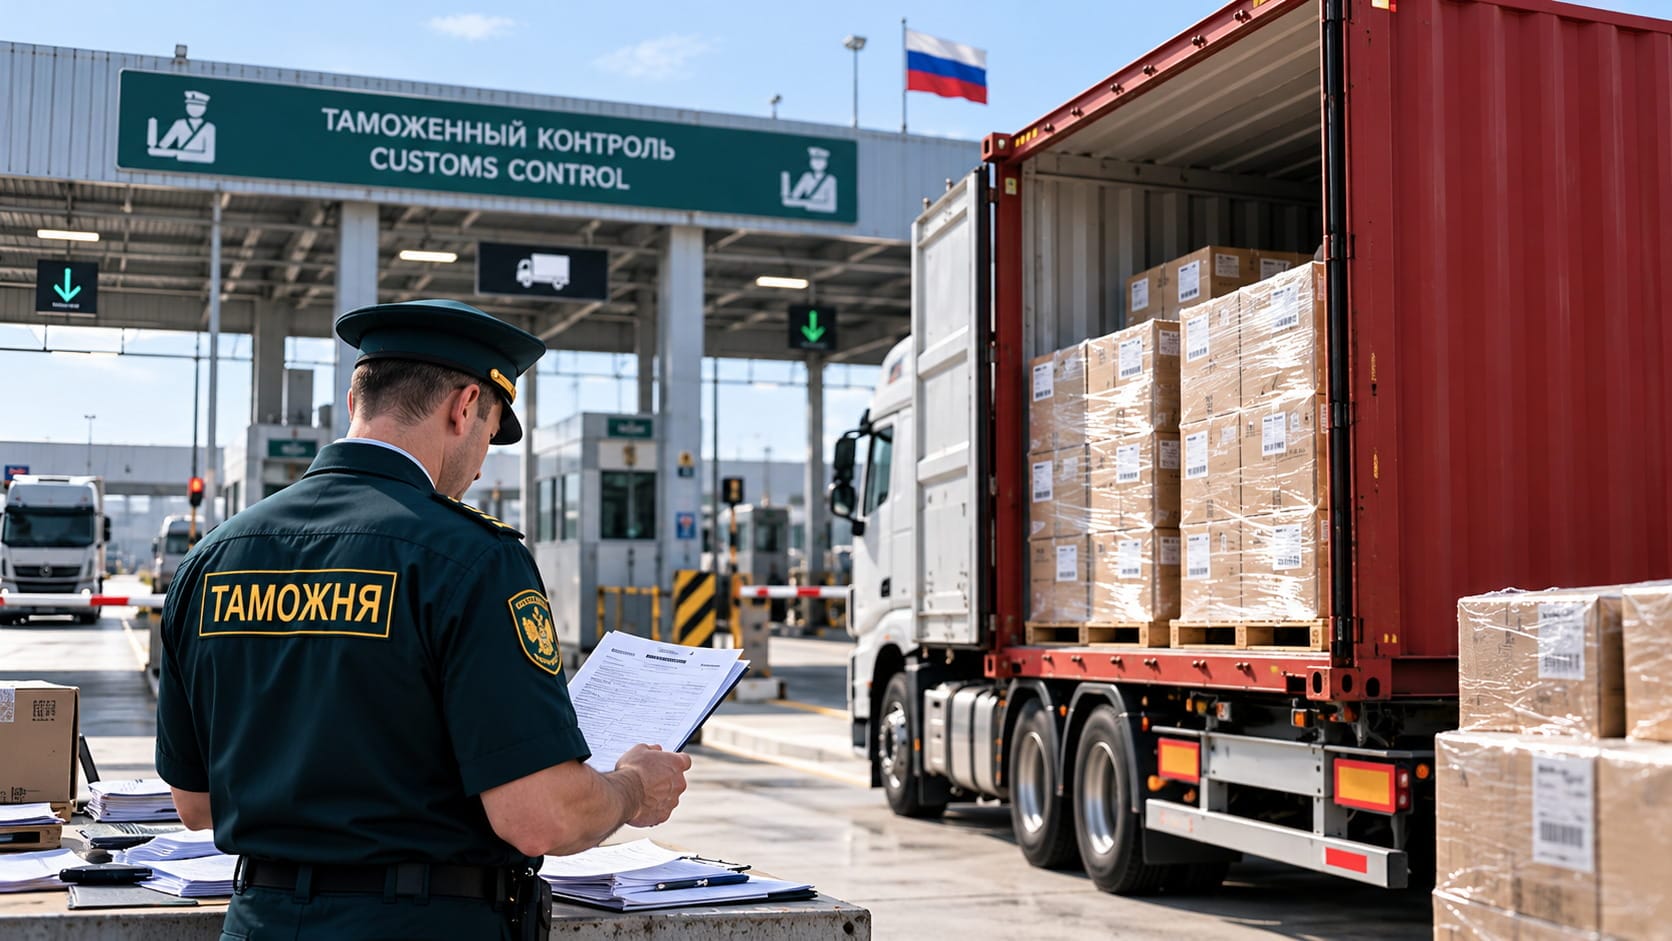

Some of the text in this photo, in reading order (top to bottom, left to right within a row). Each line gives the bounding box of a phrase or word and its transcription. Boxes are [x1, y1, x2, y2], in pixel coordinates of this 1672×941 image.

[321, 107, 675, 161] ТАМОЖЕННЫЙ КОНТРОЛЬ
[370, 147, 630, 190] CUSTOMS CONTROL
[211, 583, 383, 623] ТАМОЖНЯ
